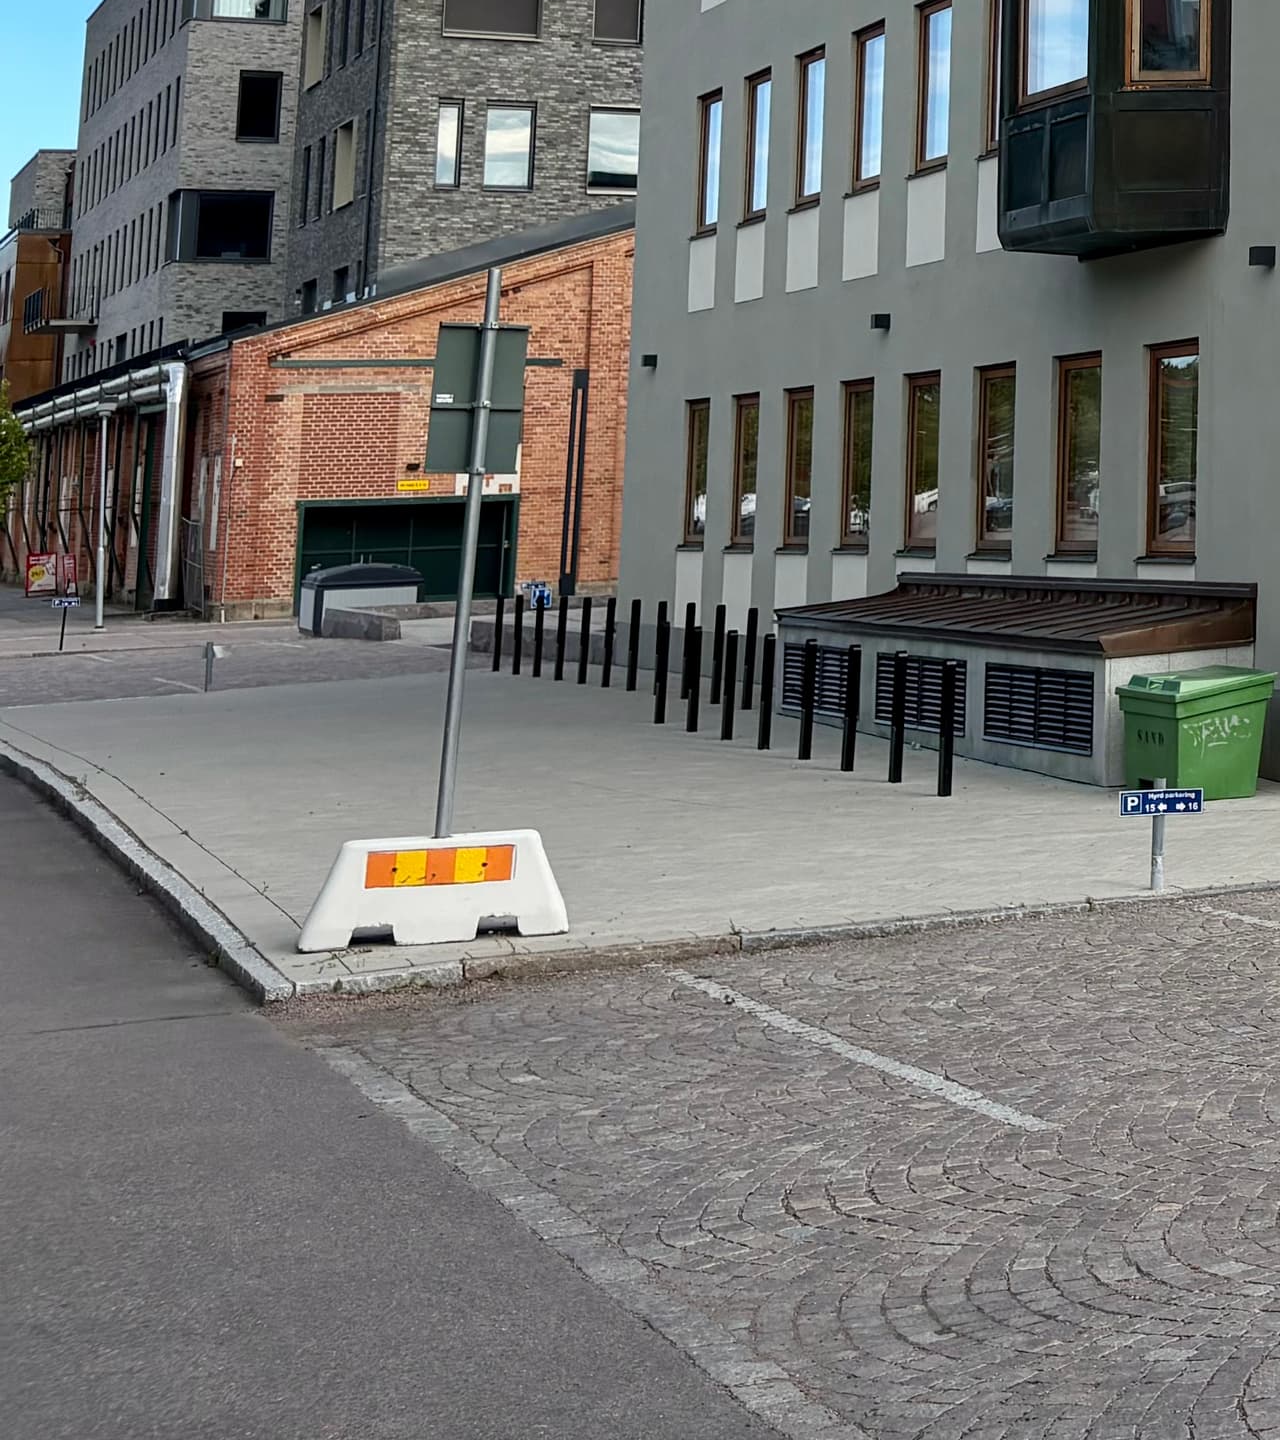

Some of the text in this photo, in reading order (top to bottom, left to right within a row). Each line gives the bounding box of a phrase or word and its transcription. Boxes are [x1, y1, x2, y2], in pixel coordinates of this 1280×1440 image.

[1165, 792, 1195, 800] parkering
[1127, 796, 1139, 811] P
[1145, 802, 1198, 812] 15 16
